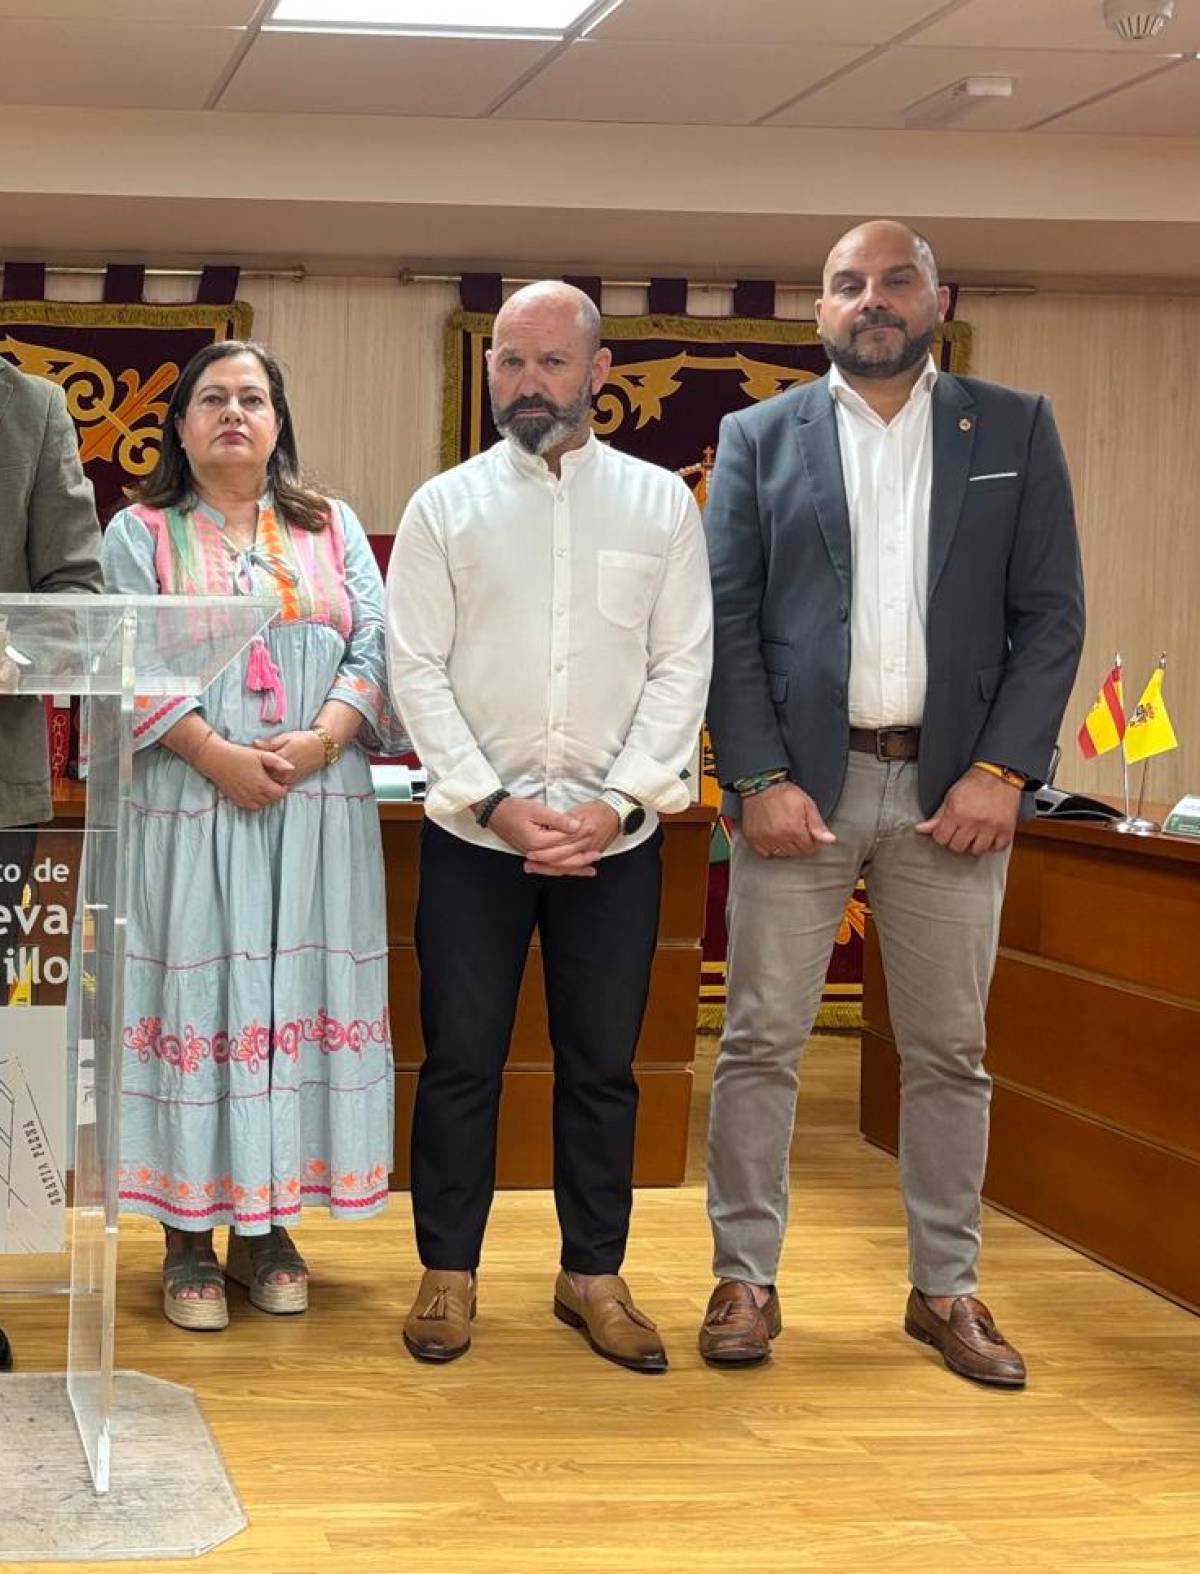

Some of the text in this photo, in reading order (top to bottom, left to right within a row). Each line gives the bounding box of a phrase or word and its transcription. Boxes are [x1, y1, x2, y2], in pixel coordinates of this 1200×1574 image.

[33, 857, 70, 883] de
[22, 1120, 63, 1206] GRATIA PLENA
